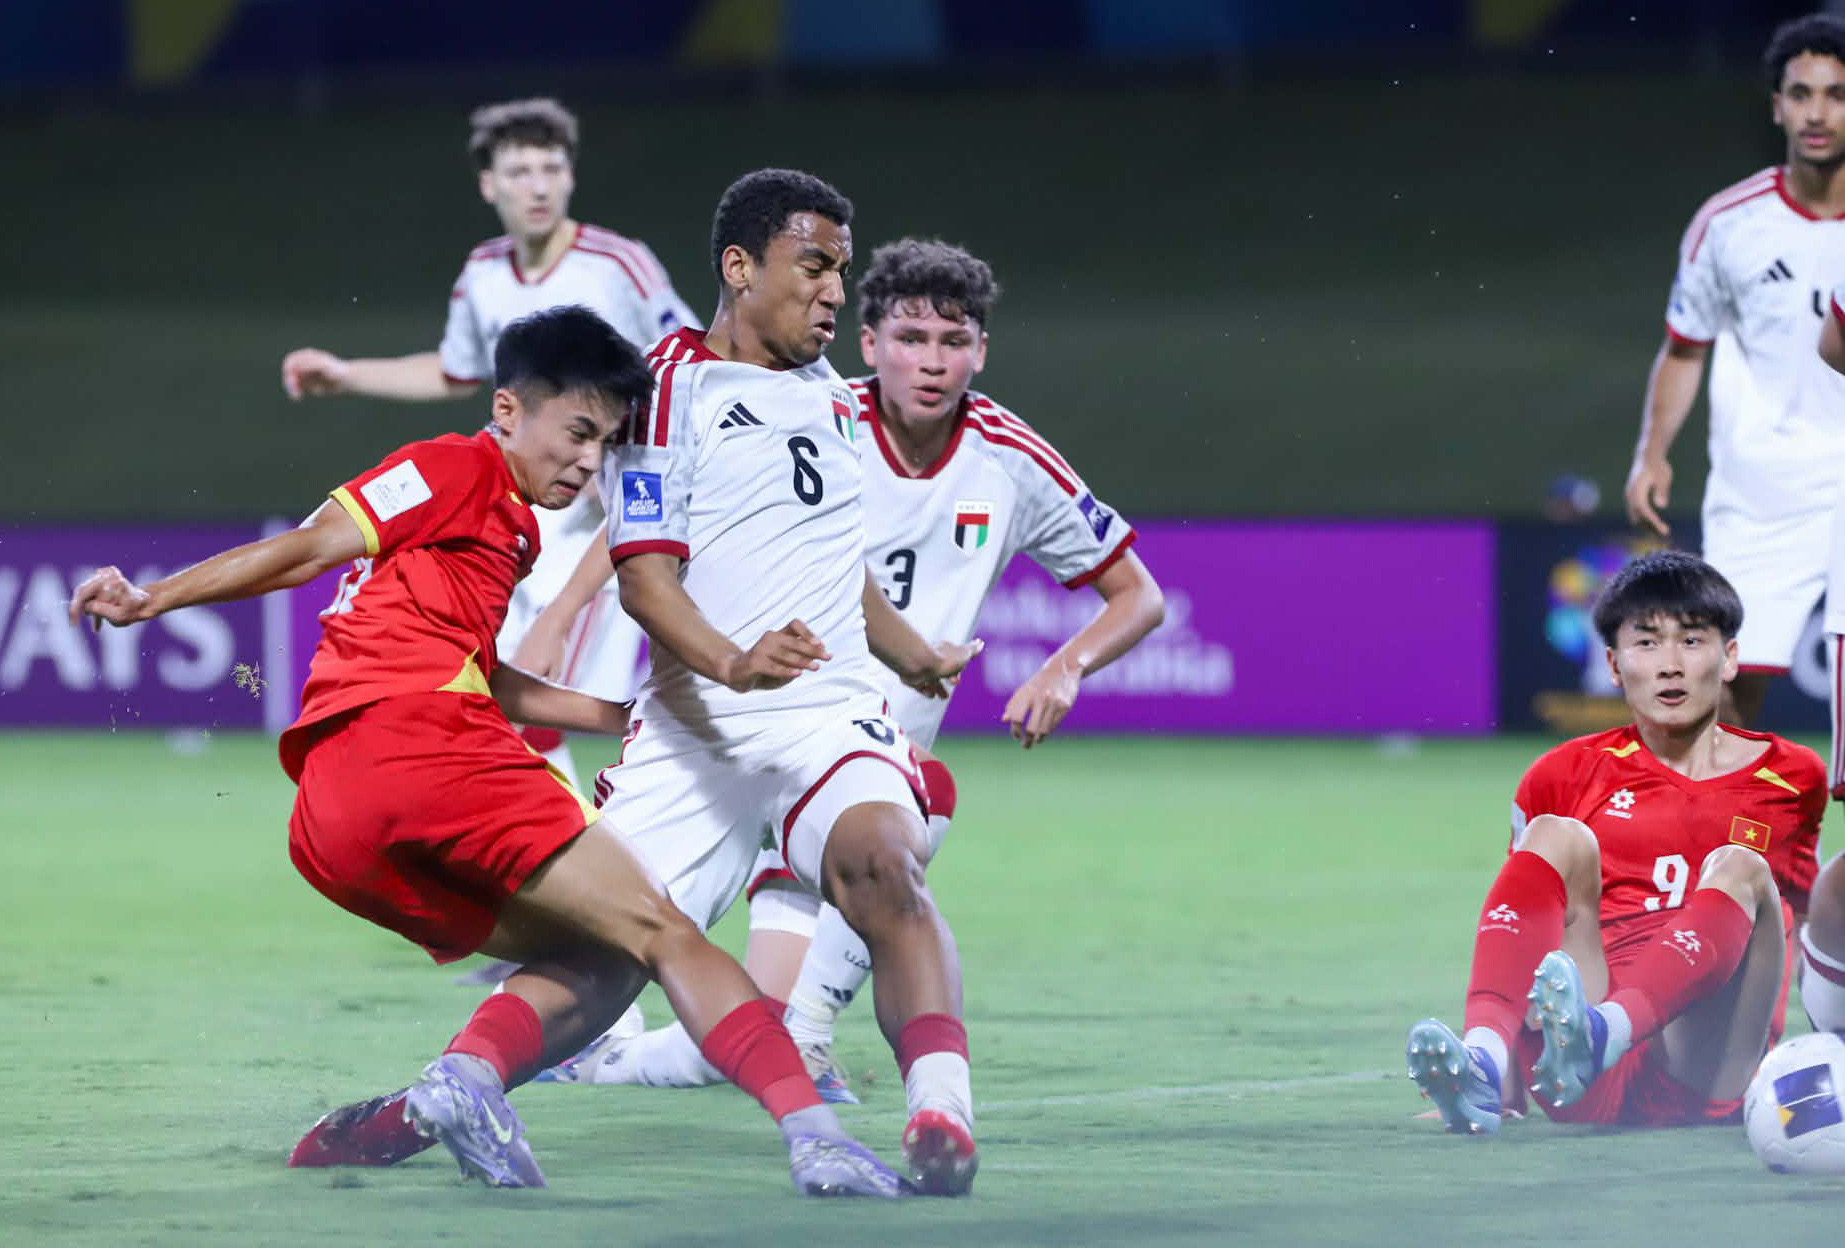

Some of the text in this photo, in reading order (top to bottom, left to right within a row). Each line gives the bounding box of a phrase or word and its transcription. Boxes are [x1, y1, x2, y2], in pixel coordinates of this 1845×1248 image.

[788, 436, 823, 506] 6
[885, 549, 916, 610] 3
[0, 565, 236, 691] AYS
[1644, 854, 1689, 912] 9
